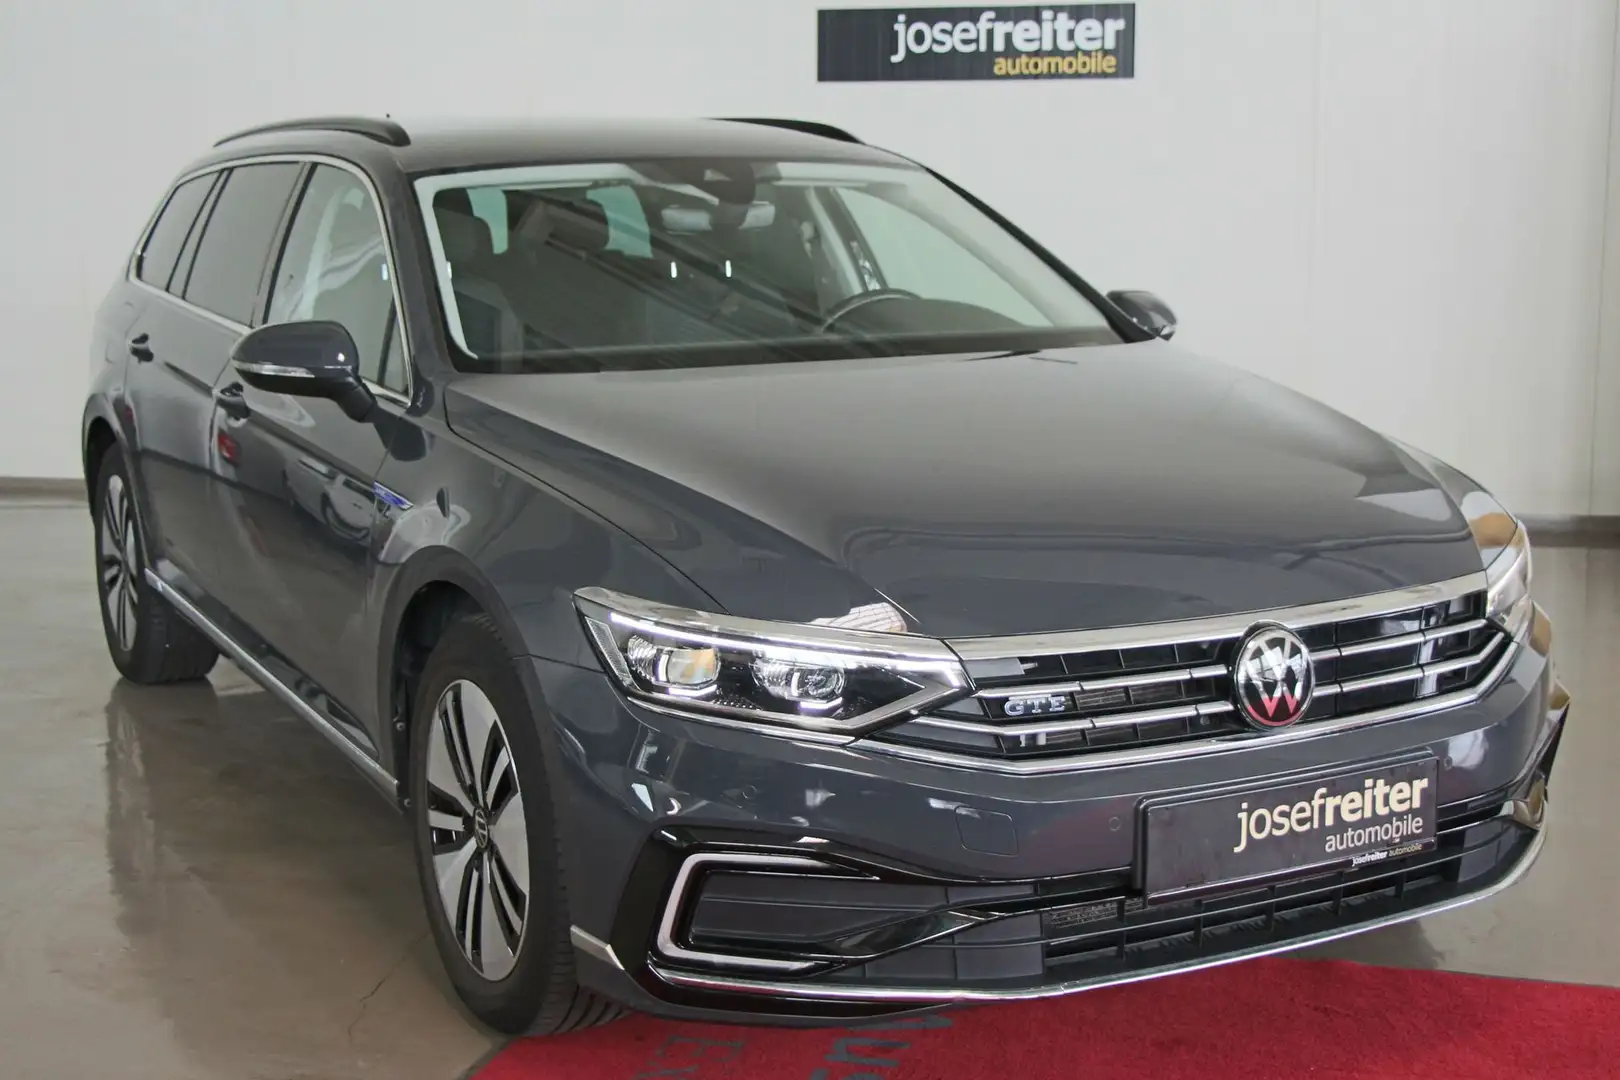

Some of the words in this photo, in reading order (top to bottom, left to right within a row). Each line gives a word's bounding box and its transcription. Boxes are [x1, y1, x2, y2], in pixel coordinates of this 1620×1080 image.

[890, 10, 1126, 63] josefreiter
[993, 51, 1117, 76] automobile
[1003, 696, 1066, 717] GTE
[1233, 777, 1429, 853] josefreiter
[1324, 814, 1424, 852] automobile
[1388, 843, 1423, 857] automobile
